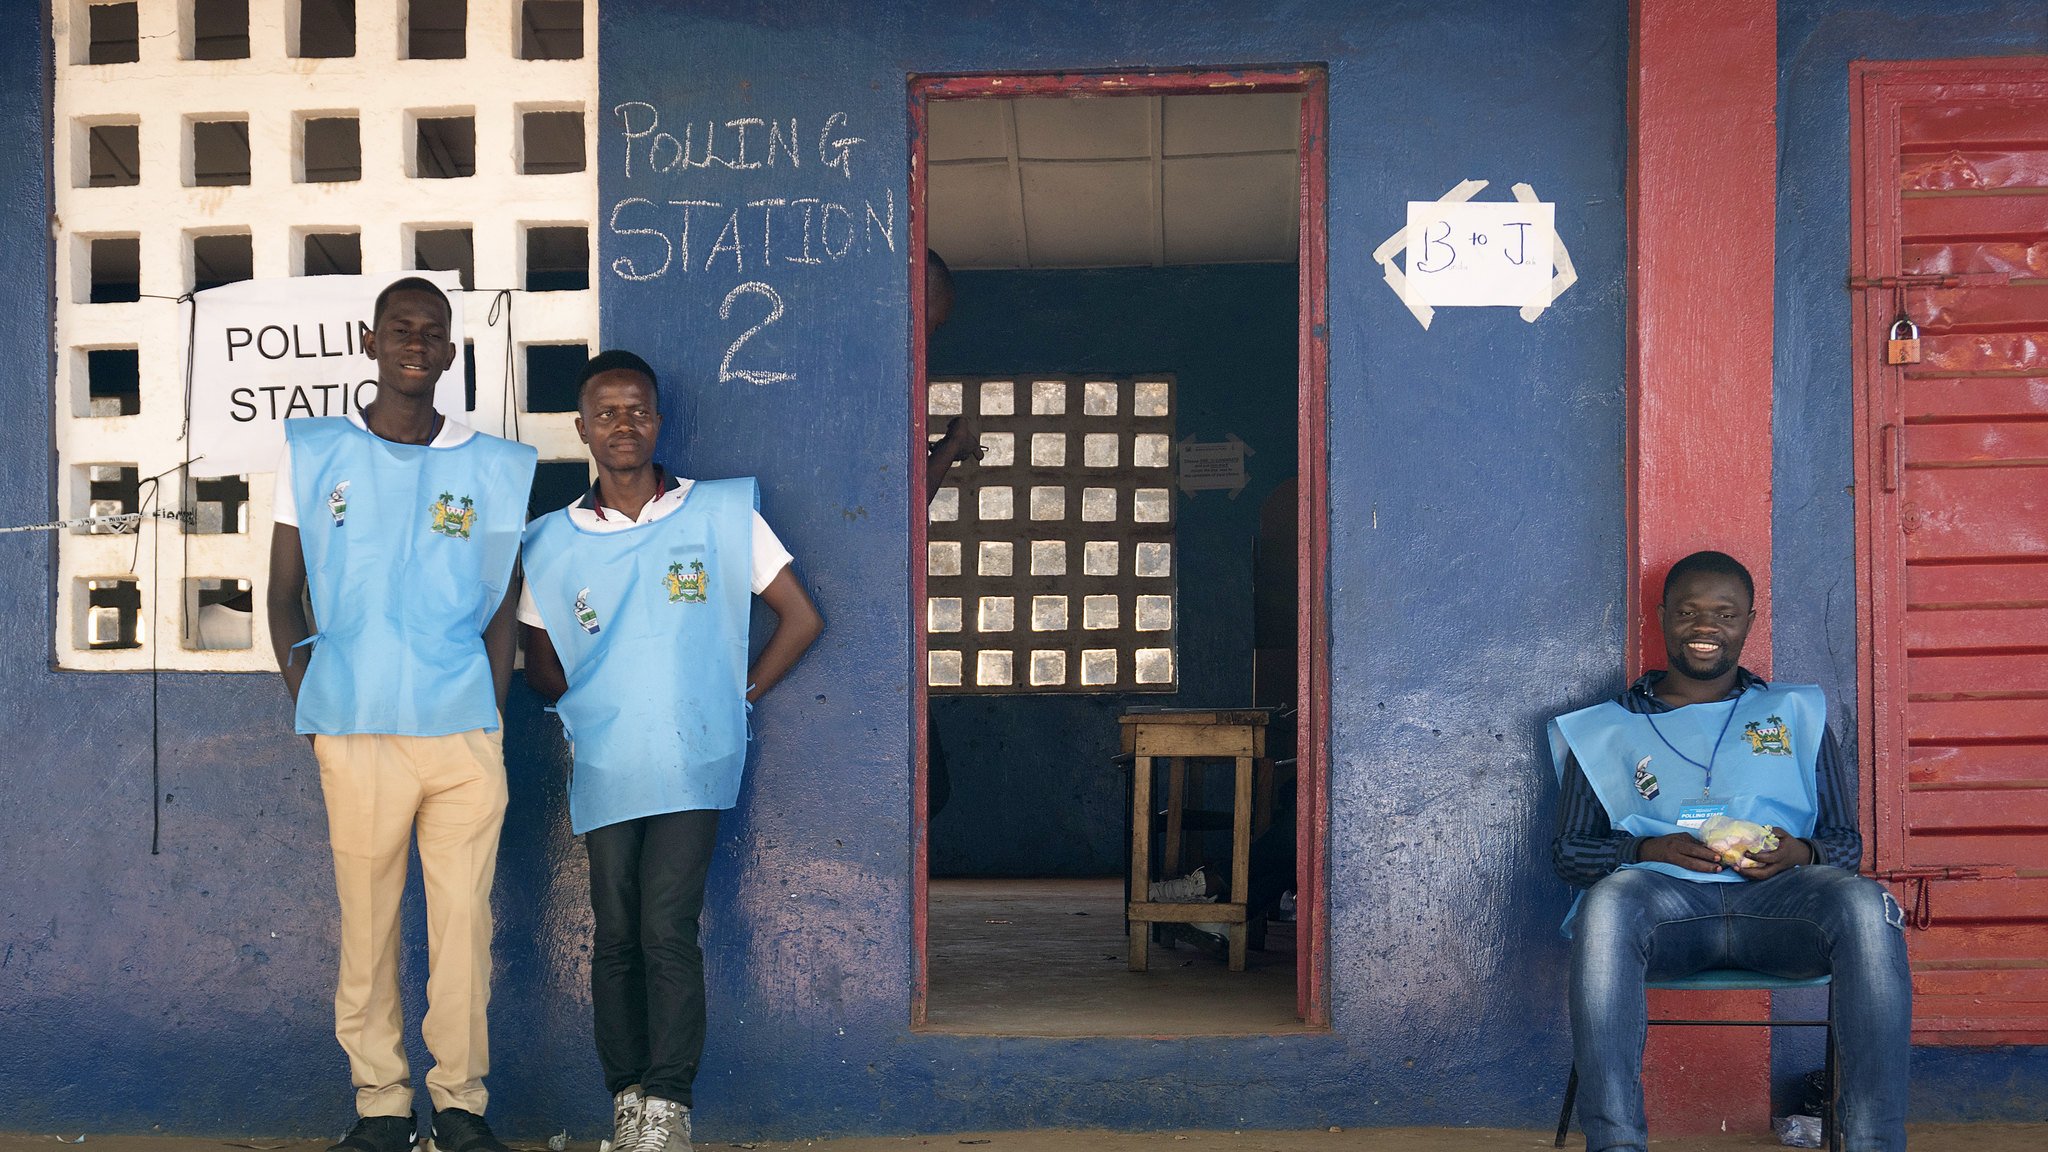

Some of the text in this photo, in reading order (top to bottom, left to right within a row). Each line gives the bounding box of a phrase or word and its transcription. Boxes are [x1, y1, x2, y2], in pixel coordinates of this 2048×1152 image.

[610, 188, 895, 281] STATION
[1417, 221, 1532, 273] B to J
[226, 320, 374, 361] POLLI
[719, 281, 797, 386] 2
[230, 379, 378, 422] STATIO
